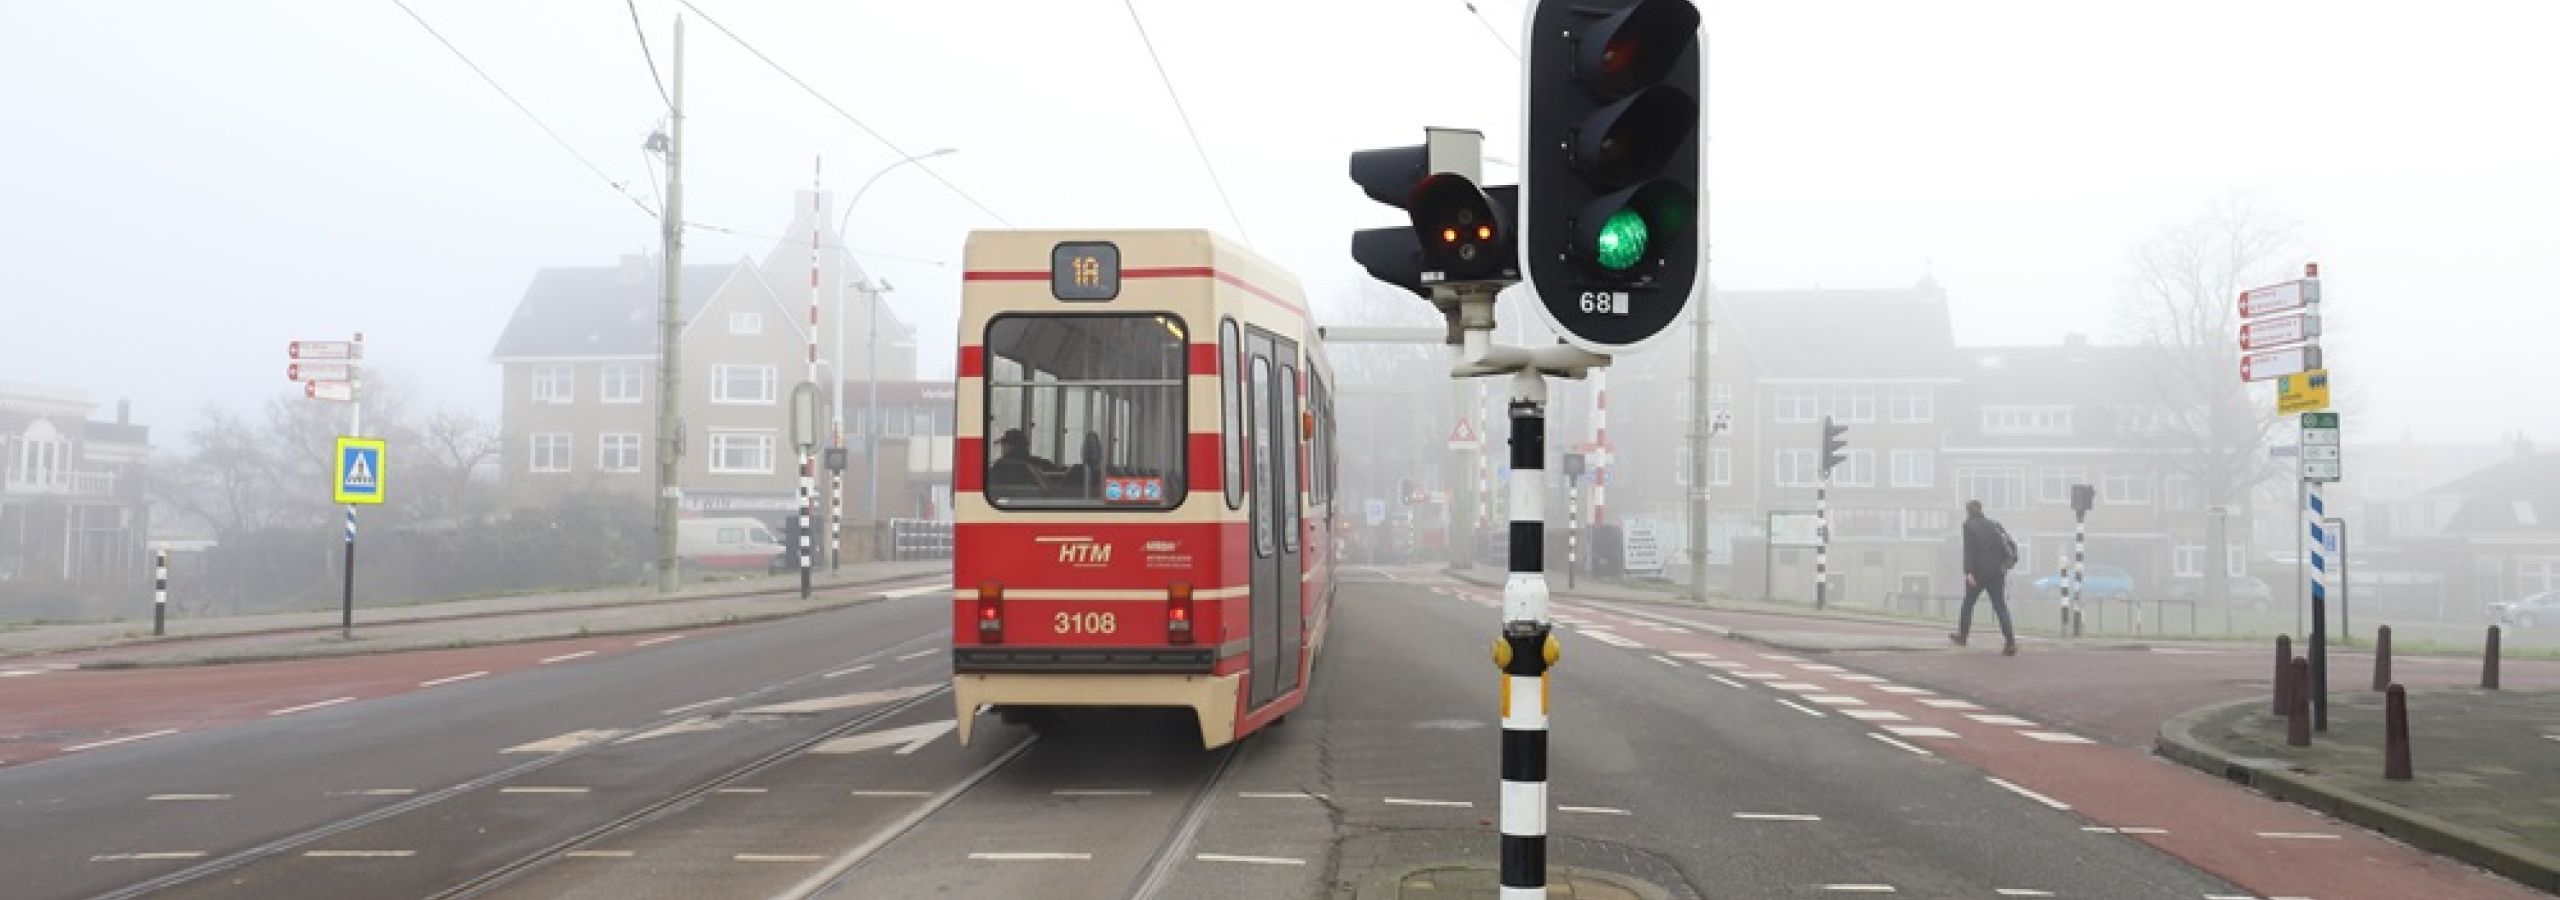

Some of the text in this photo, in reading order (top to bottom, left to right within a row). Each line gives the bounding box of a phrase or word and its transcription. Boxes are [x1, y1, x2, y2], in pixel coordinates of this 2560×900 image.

[1072, 256, 1099, 288] 1A
[1580, 292, 1611, 313] 68
[1058, 543, 1112, 562] HTM
[1054, 612, 1116, 634] 3108
